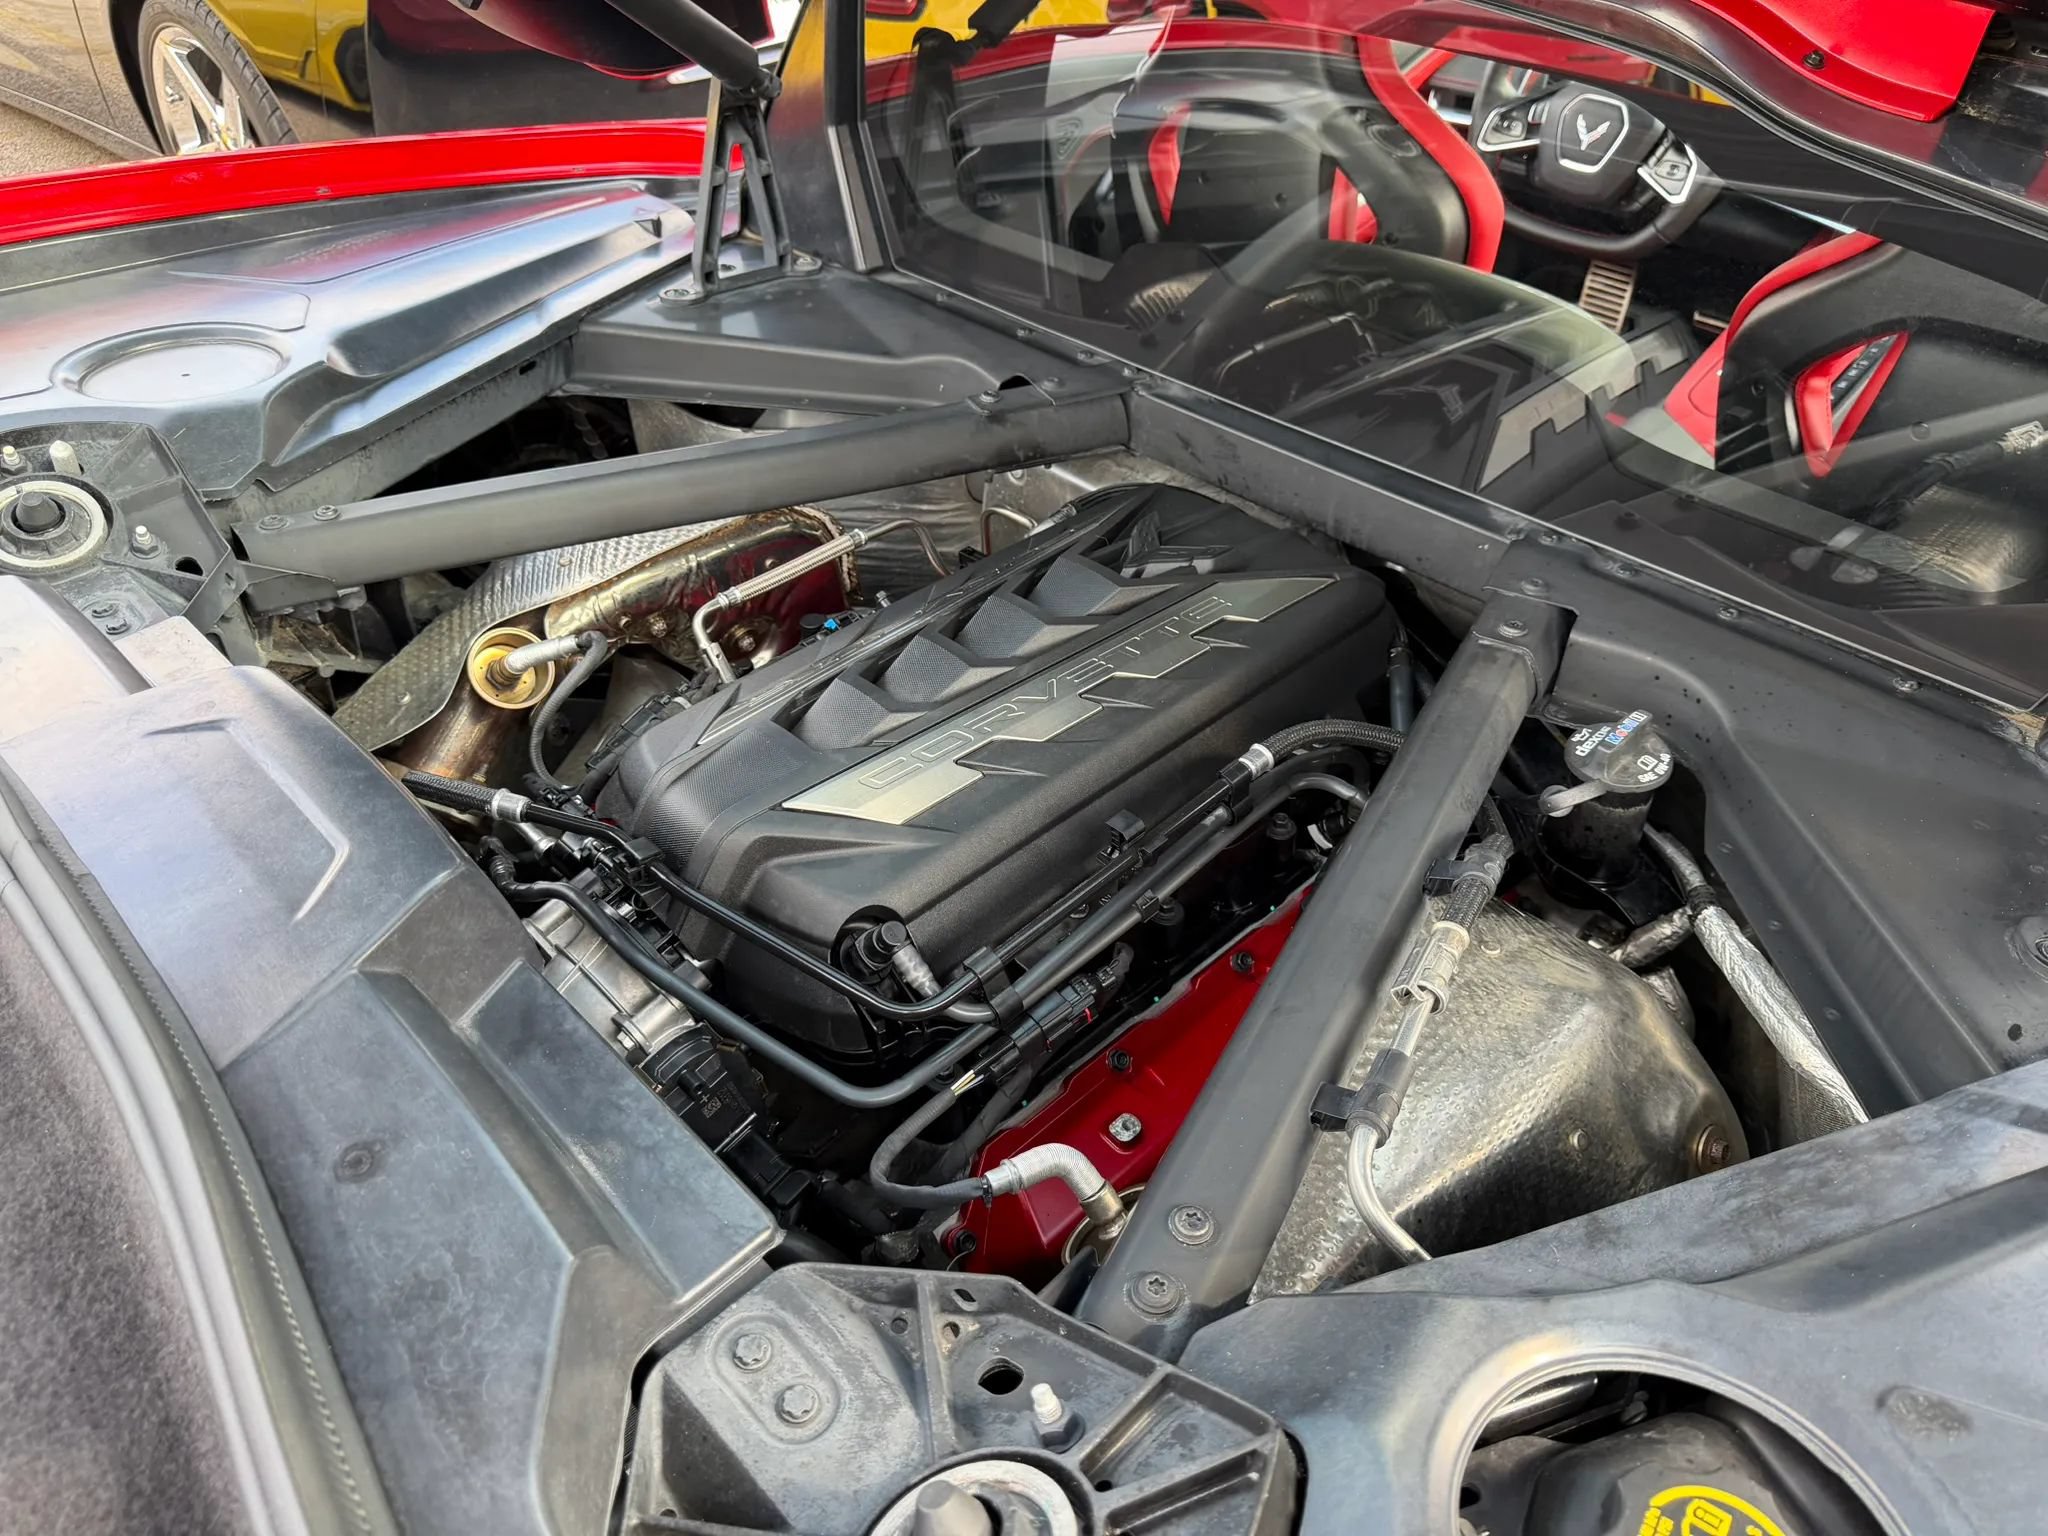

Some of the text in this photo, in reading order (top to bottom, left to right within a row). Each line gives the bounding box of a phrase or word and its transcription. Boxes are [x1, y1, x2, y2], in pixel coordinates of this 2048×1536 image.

[858, 597, 1232, 789] CORVETTE
[1575, 726, 1611, 756] dexos
[1605, 718, 1639, 744] Mobil
[1637, 753, 1671, 783] SAE 0W-40
